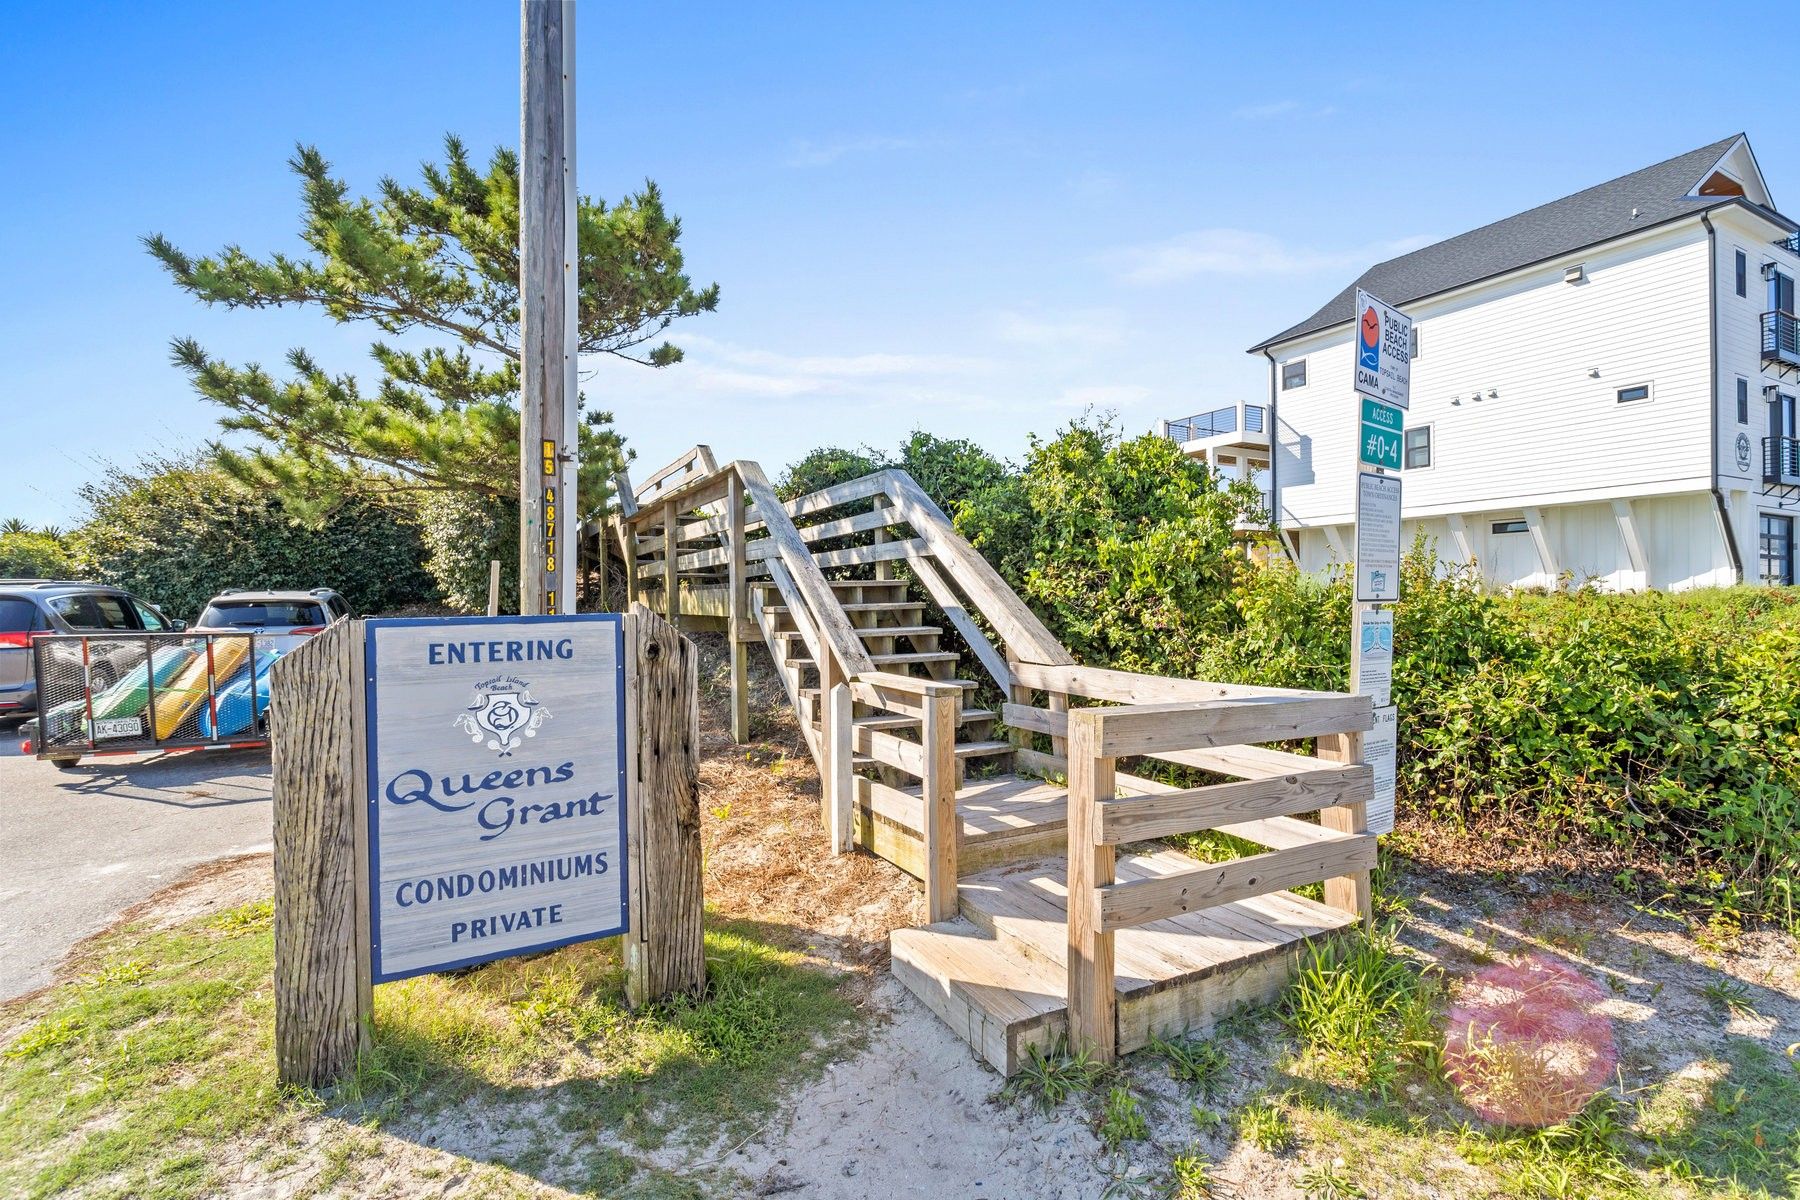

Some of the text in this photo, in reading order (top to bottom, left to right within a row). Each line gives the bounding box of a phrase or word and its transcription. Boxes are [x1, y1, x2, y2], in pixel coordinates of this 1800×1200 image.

[1384, 315, 1408, 337] PUBLIC
[1385, 328, 1408, 351] BEACH
[1382, 342, 1409, 364] ACCESS
[1358, 370, 1379, 389] CAMA
[1396, 374, 1408, 385] BEACH
[1371, 407, 1394, 425] ACCESS
[428, 638, 574, 665] ENTERING
[474, 675, 531, 691] Topsail Island
[490, 683, 513, 692] Beach
[385, 761, 574, 812] Queens
[477, 791, 614, 841] Grant
[395, 851, 609, 908] CONDOMINIUMS
[451, 903, 563, 943] PRIVATE
